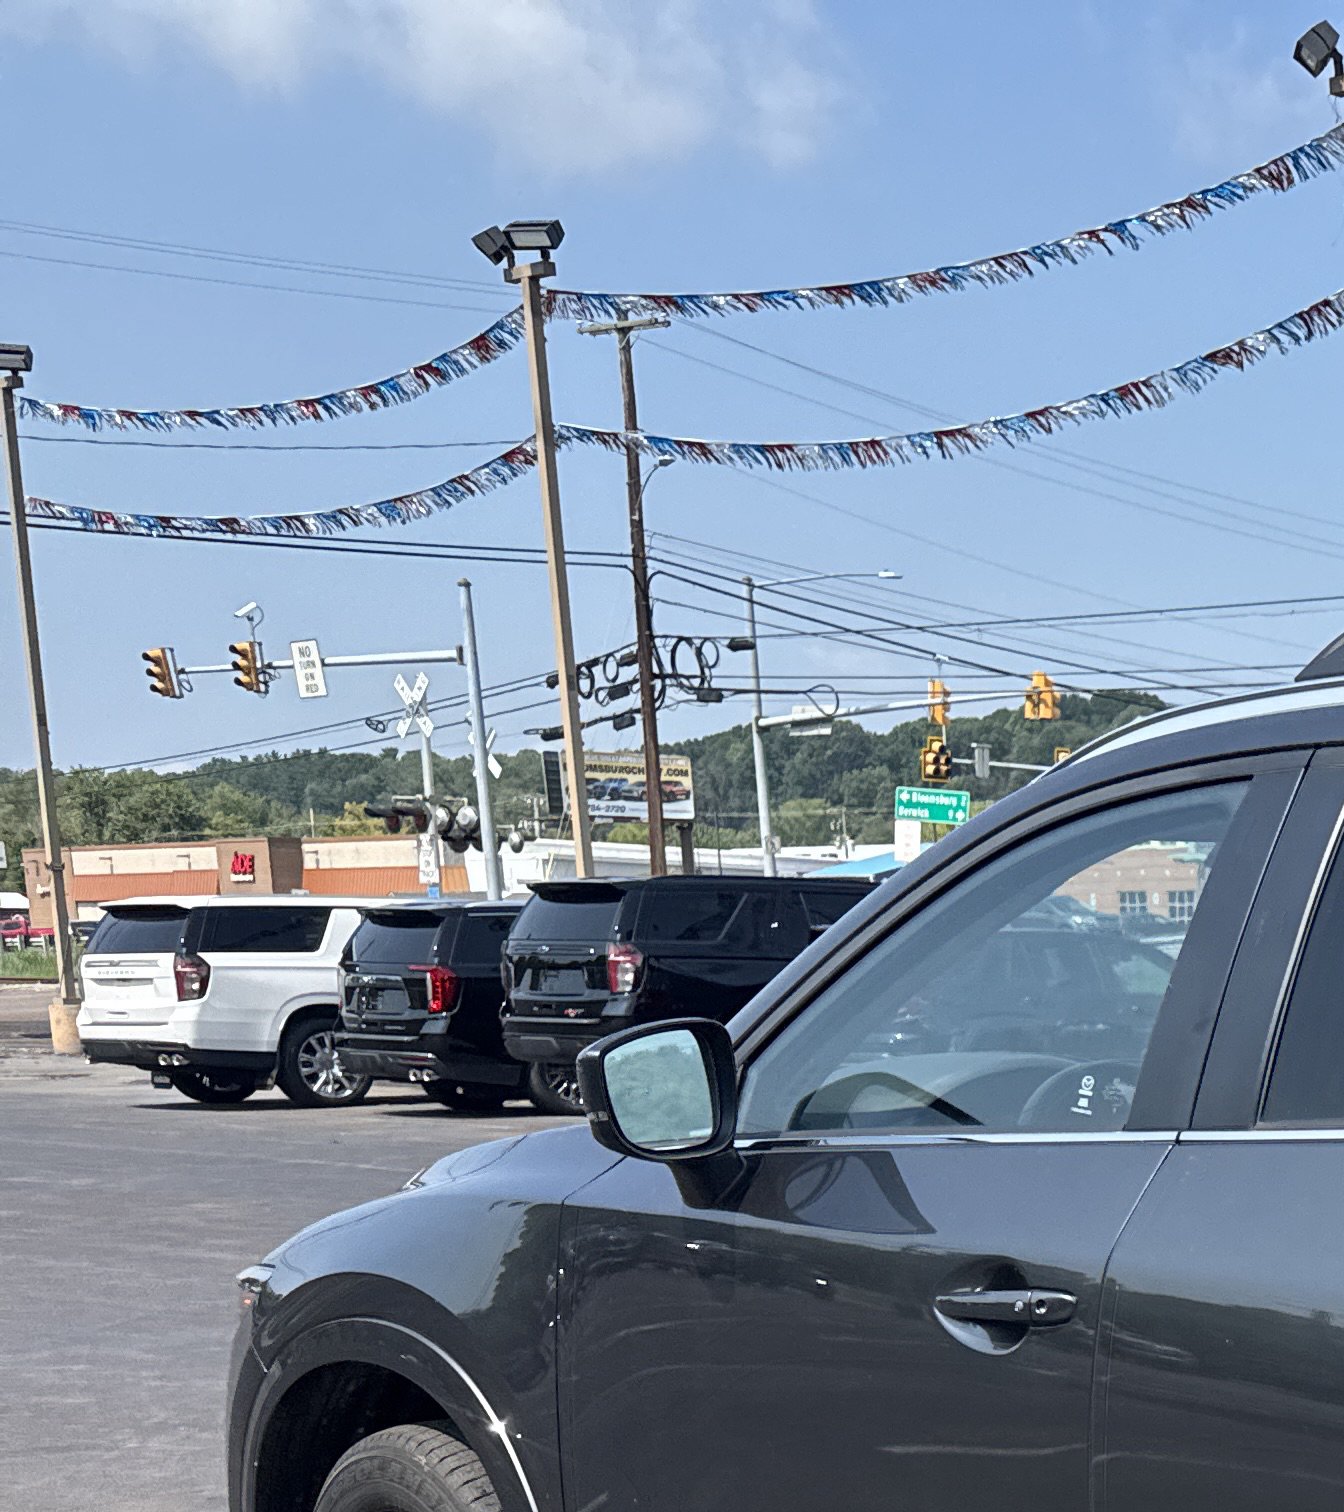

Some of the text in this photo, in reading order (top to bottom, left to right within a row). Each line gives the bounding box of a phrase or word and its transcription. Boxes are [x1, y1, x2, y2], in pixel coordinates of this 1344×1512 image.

[298, 645, 311, 658] NO
[305, 672, 315, 681] ON
[305, 683, 319, 693] RED
[911, 791, 957, 807] Bloomsburg
